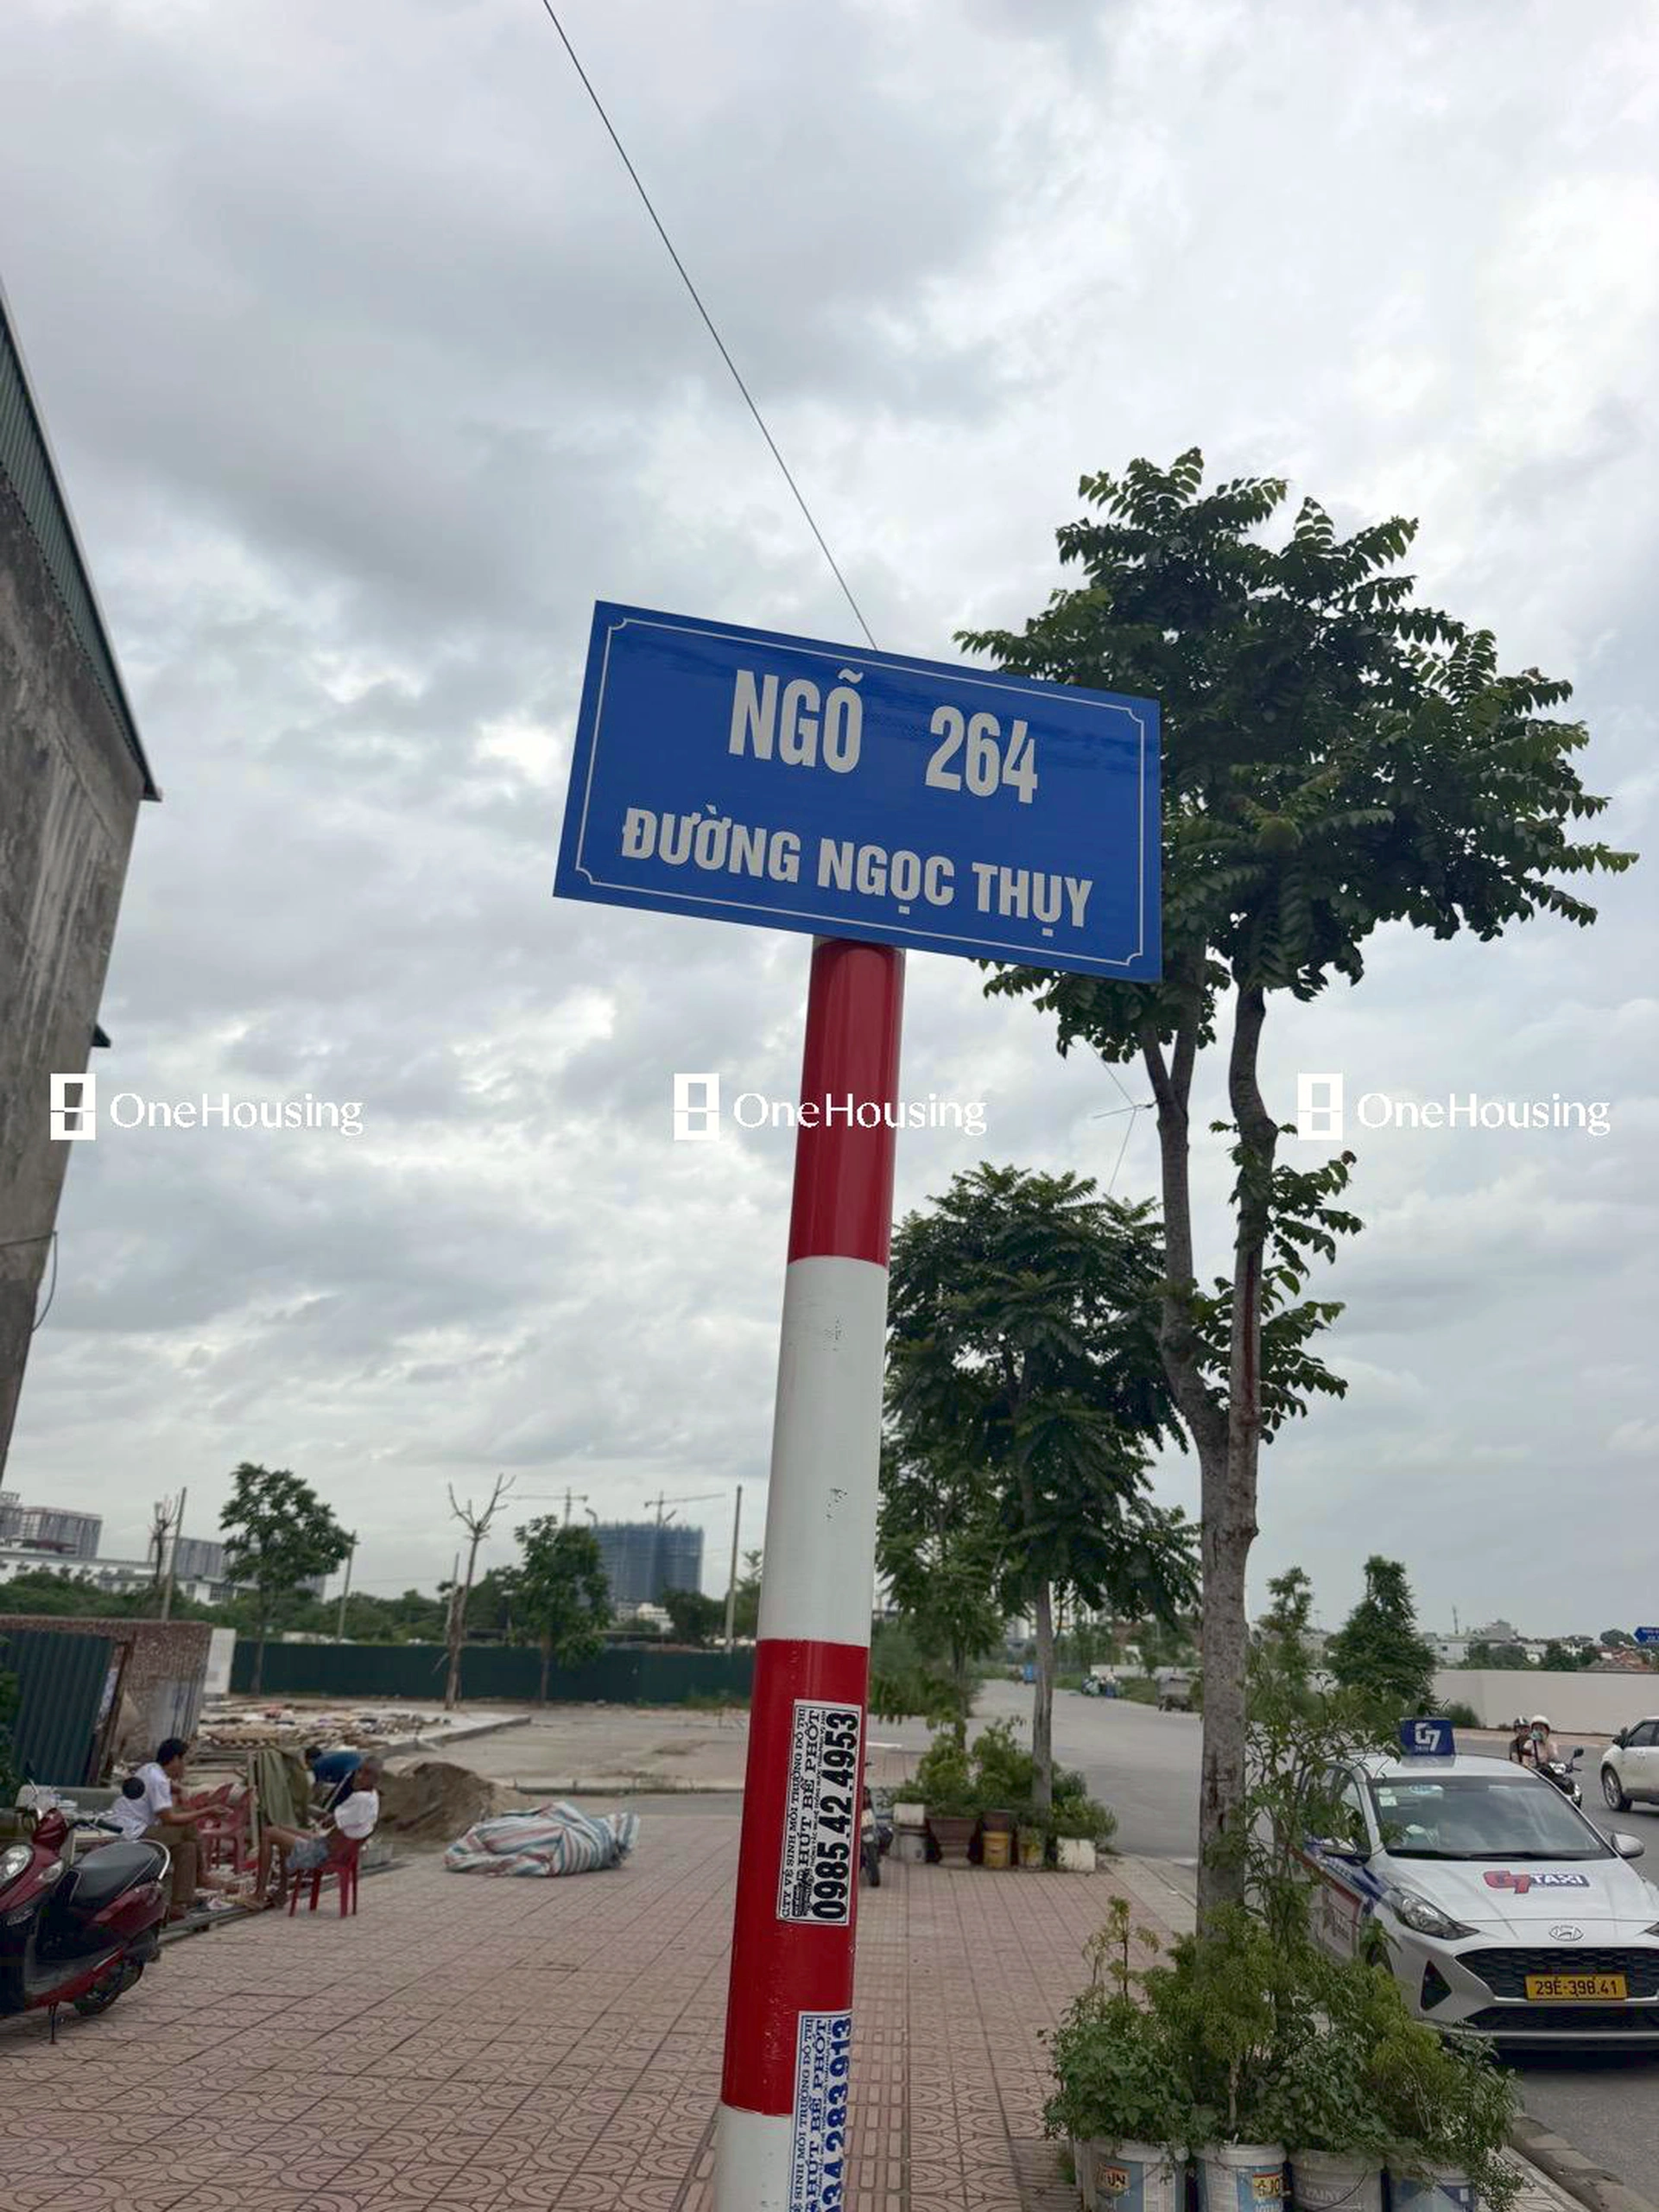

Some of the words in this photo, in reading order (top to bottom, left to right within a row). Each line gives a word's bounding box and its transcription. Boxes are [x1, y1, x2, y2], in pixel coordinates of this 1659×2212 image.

[728, 667, 864, 774] NGÕ
[925, 706, 1038, 804] 264
[620, 804, 801, 883] ĐƯỜNG
[817, 838, 955, 916] NGỌC
[972, 862, 1093, 936] THỤY
[804, 1710, 820, 1772] PHỐT
[788, 1808, 797, 1831] MÔI
[797, 1816, 812, 1867] HÚT
[786, 1835, 796, 1867] SINH
[1530, 1873, 1585, 1885] TAXI
[799, 2069, 810, 2128] TRƯỜNG
[805, 2141, 819, 2197] HÚT
[812, 2020, 826, 2090] PHỐT
[795, 2132, 806, 2159] MÔI
[794, 2164, 804, 2199] SINH
